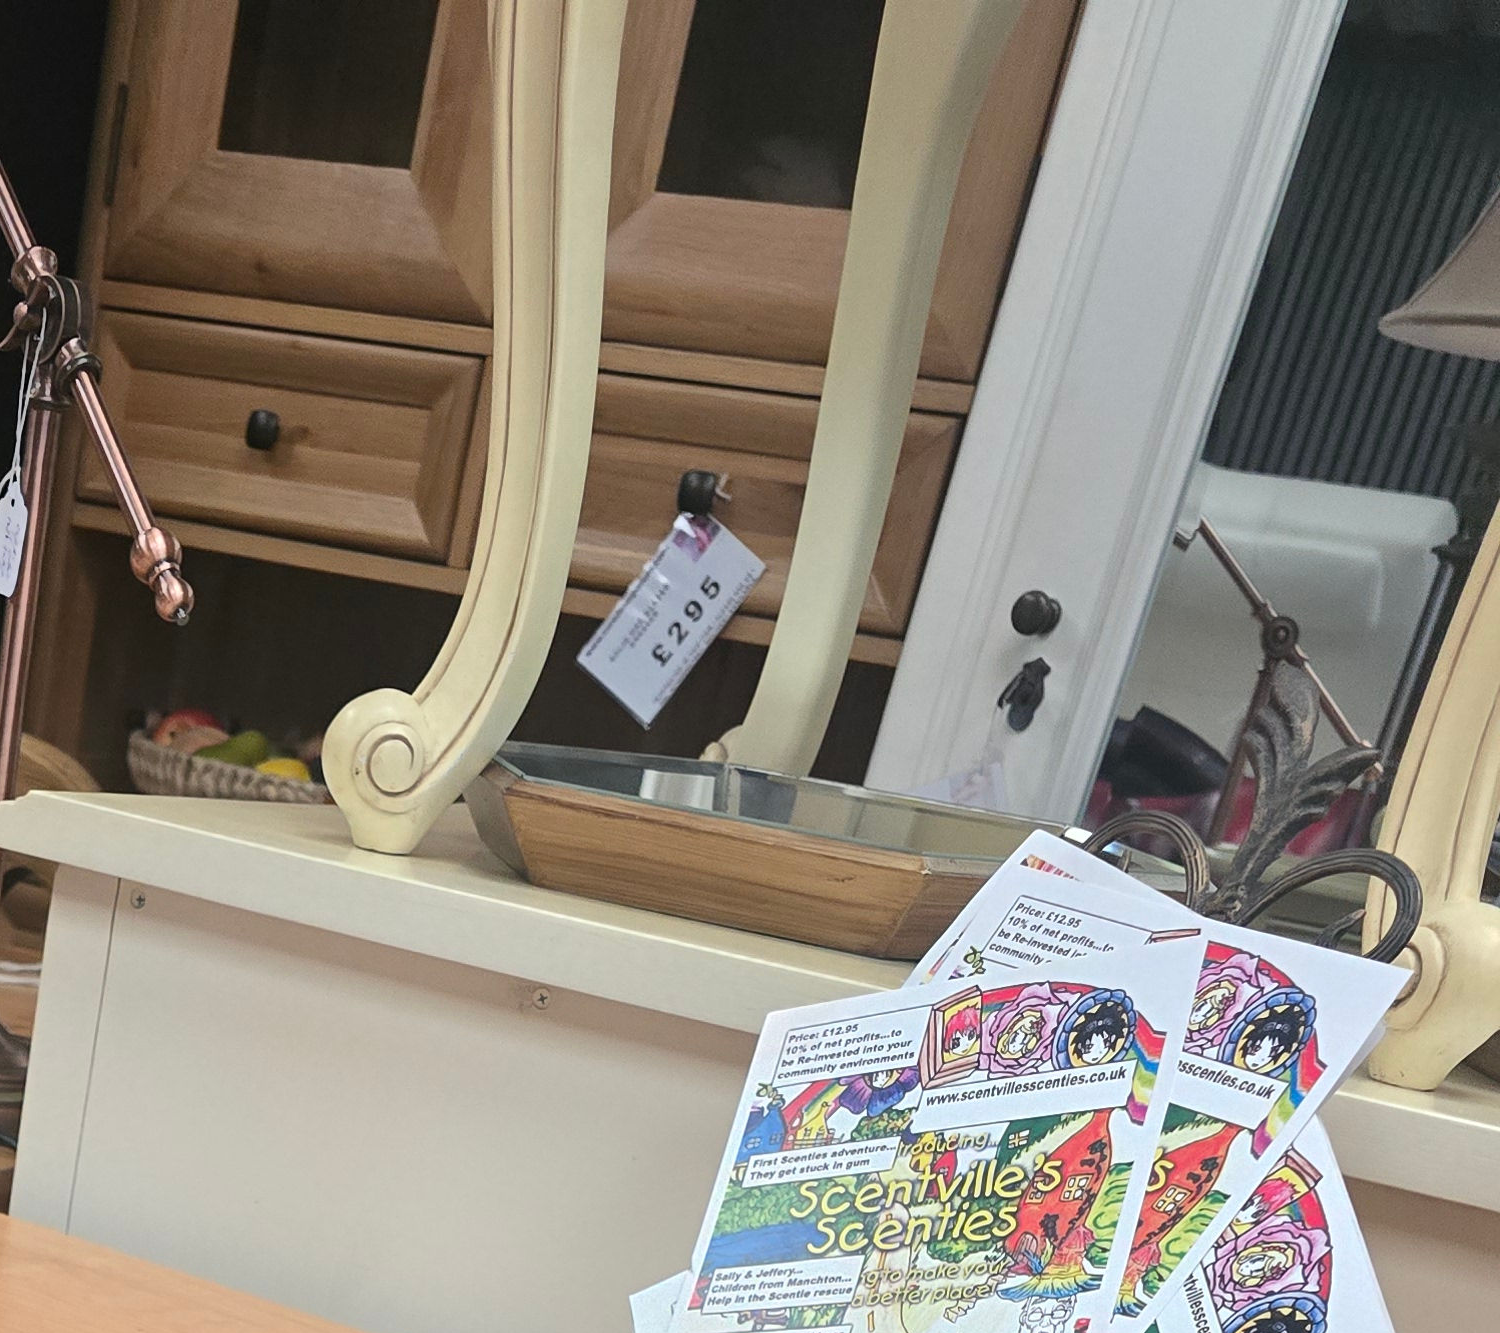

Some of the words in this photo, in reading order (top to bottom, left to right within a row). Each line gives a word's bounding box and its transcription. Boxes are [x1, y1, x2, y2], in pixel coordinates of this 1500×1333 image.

[651, 573, 721, 668] £295
[1007, 915, 1028, 930] 10%
[1029, 921, 1041, 932] of
[1041, 926, 1060, 938] net
[1014, 902, 1045, 919] Price:
[1045, 911, 1082, 928] £12.95
[988, 943, 1044, 966] community
[997, 928, 1011, 940] be
[1011, 934, 1070, 958] Re-invested
[788, 1033, 819, 1044] Price:
[821, 1023, 860, 1038] £12.95
[781, 1057, 794, 1068] be
[797, 1047, 860, 1065] Re-invested
[862, 1043, 884, 1054] into
[887, 1040, 913, 1052] your
[786, 1045, 807, 1056] 10%
[810, 1041, 822, 1051] of
[824, 1038, 842, 1049] net
[777, 1062, 837, 1079] community
[839, 1051, 915, 1070] environments
[925, 1065, 1127, 1107] www.scentvillesscenties.co.uk
[1177, 1060, 1275, 1099] sscenties.co.uk
[750, 1169, 776, 1182] They
[778, 1167, 799, 1179] get
[799, 1162, 830, 1175] stuck
[832, 1160, 844, 1170] in
[846, 1158, 870, 1170] gum
[753, 1156, 778, 1169] First
[780, 1151, 828, 1166] Scenties
[789, 1153, 1062, 1219] Scentville's
[806, 1200, 1019, 1256] Scenties
[715, 1271, 742, 1282] Sally
[744, 1271, 753, 1279] &
[906, 1263, 961, 1281] make
[964, 1260, 1010, 1280] your
[707, 1296, 732, 1306] Help
[734, 1294, 745, 1303] in
[748, 1292, 766, 1302] the
[768, 1288, 811, 1300] Scentie
[813, 1286, 853, 1297] rescue
[711, 1282, 756, 1293] Children
[758, 1280, 784, 1290] from
[851, 1294, 864, 1308] a
[866, 1286, 933, 1307] better
